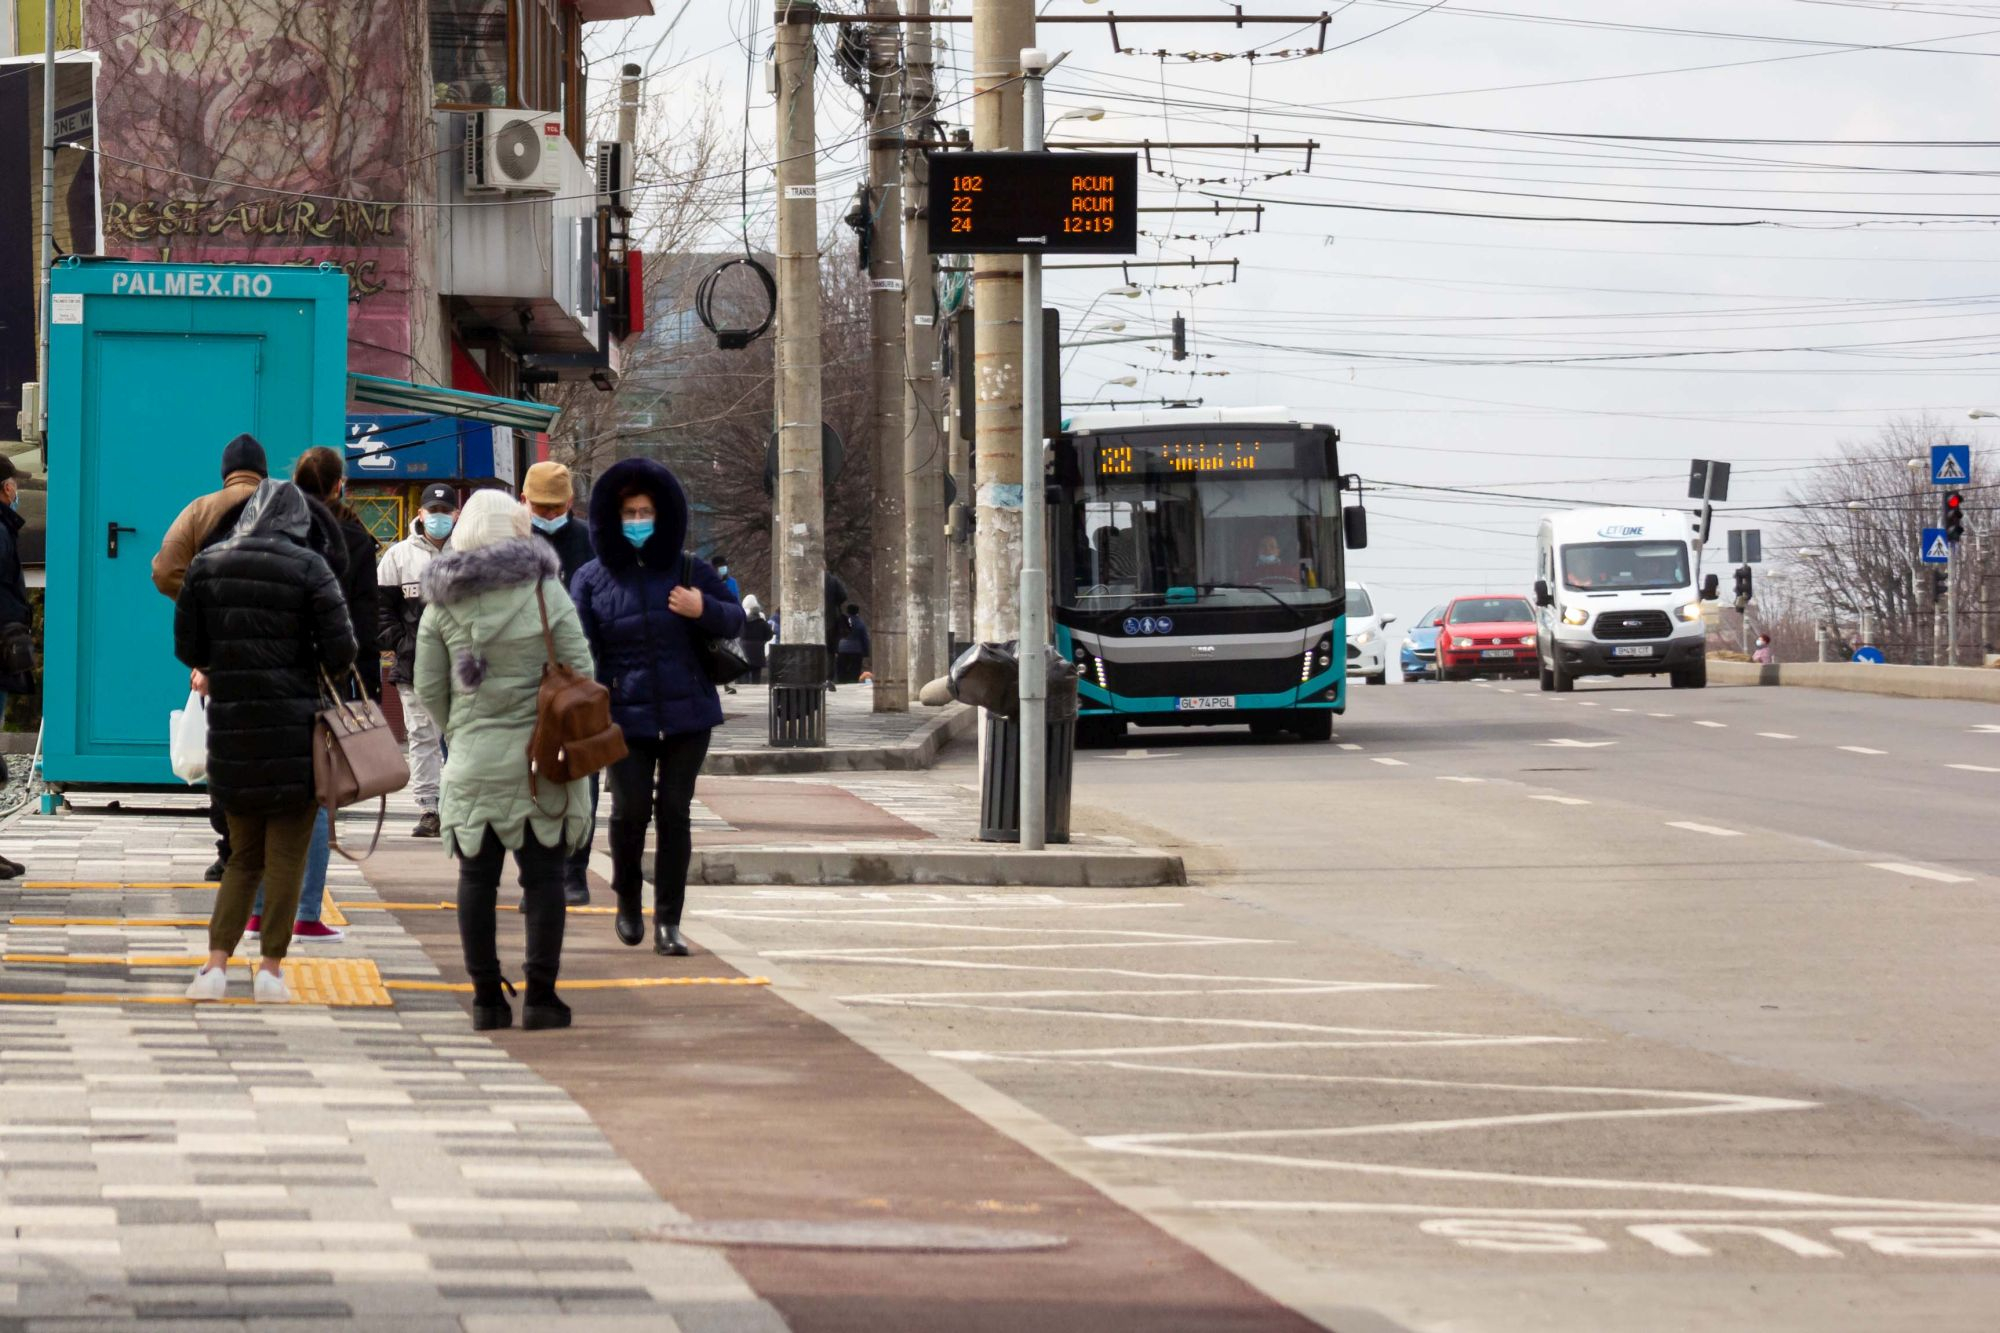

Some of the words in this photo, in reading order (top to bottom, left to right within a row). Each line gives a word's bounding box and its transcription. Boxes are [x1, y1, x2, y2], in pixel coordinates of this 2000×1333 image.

[80, 110, 93, 127] W
[953, 176, 983, 191] 102
[1072, 176, 1115, 191] ACUM
[951, 197, 973, 212] 22
[1072, 197, 1115, 212] ACUM
[103, 200, 398, 239] RESTAURANT
[951, 217, 973, 232] 24
[1063, 217, 1115, 232] 12:19
[112, 273, 272, 297] PALMEX.RO
